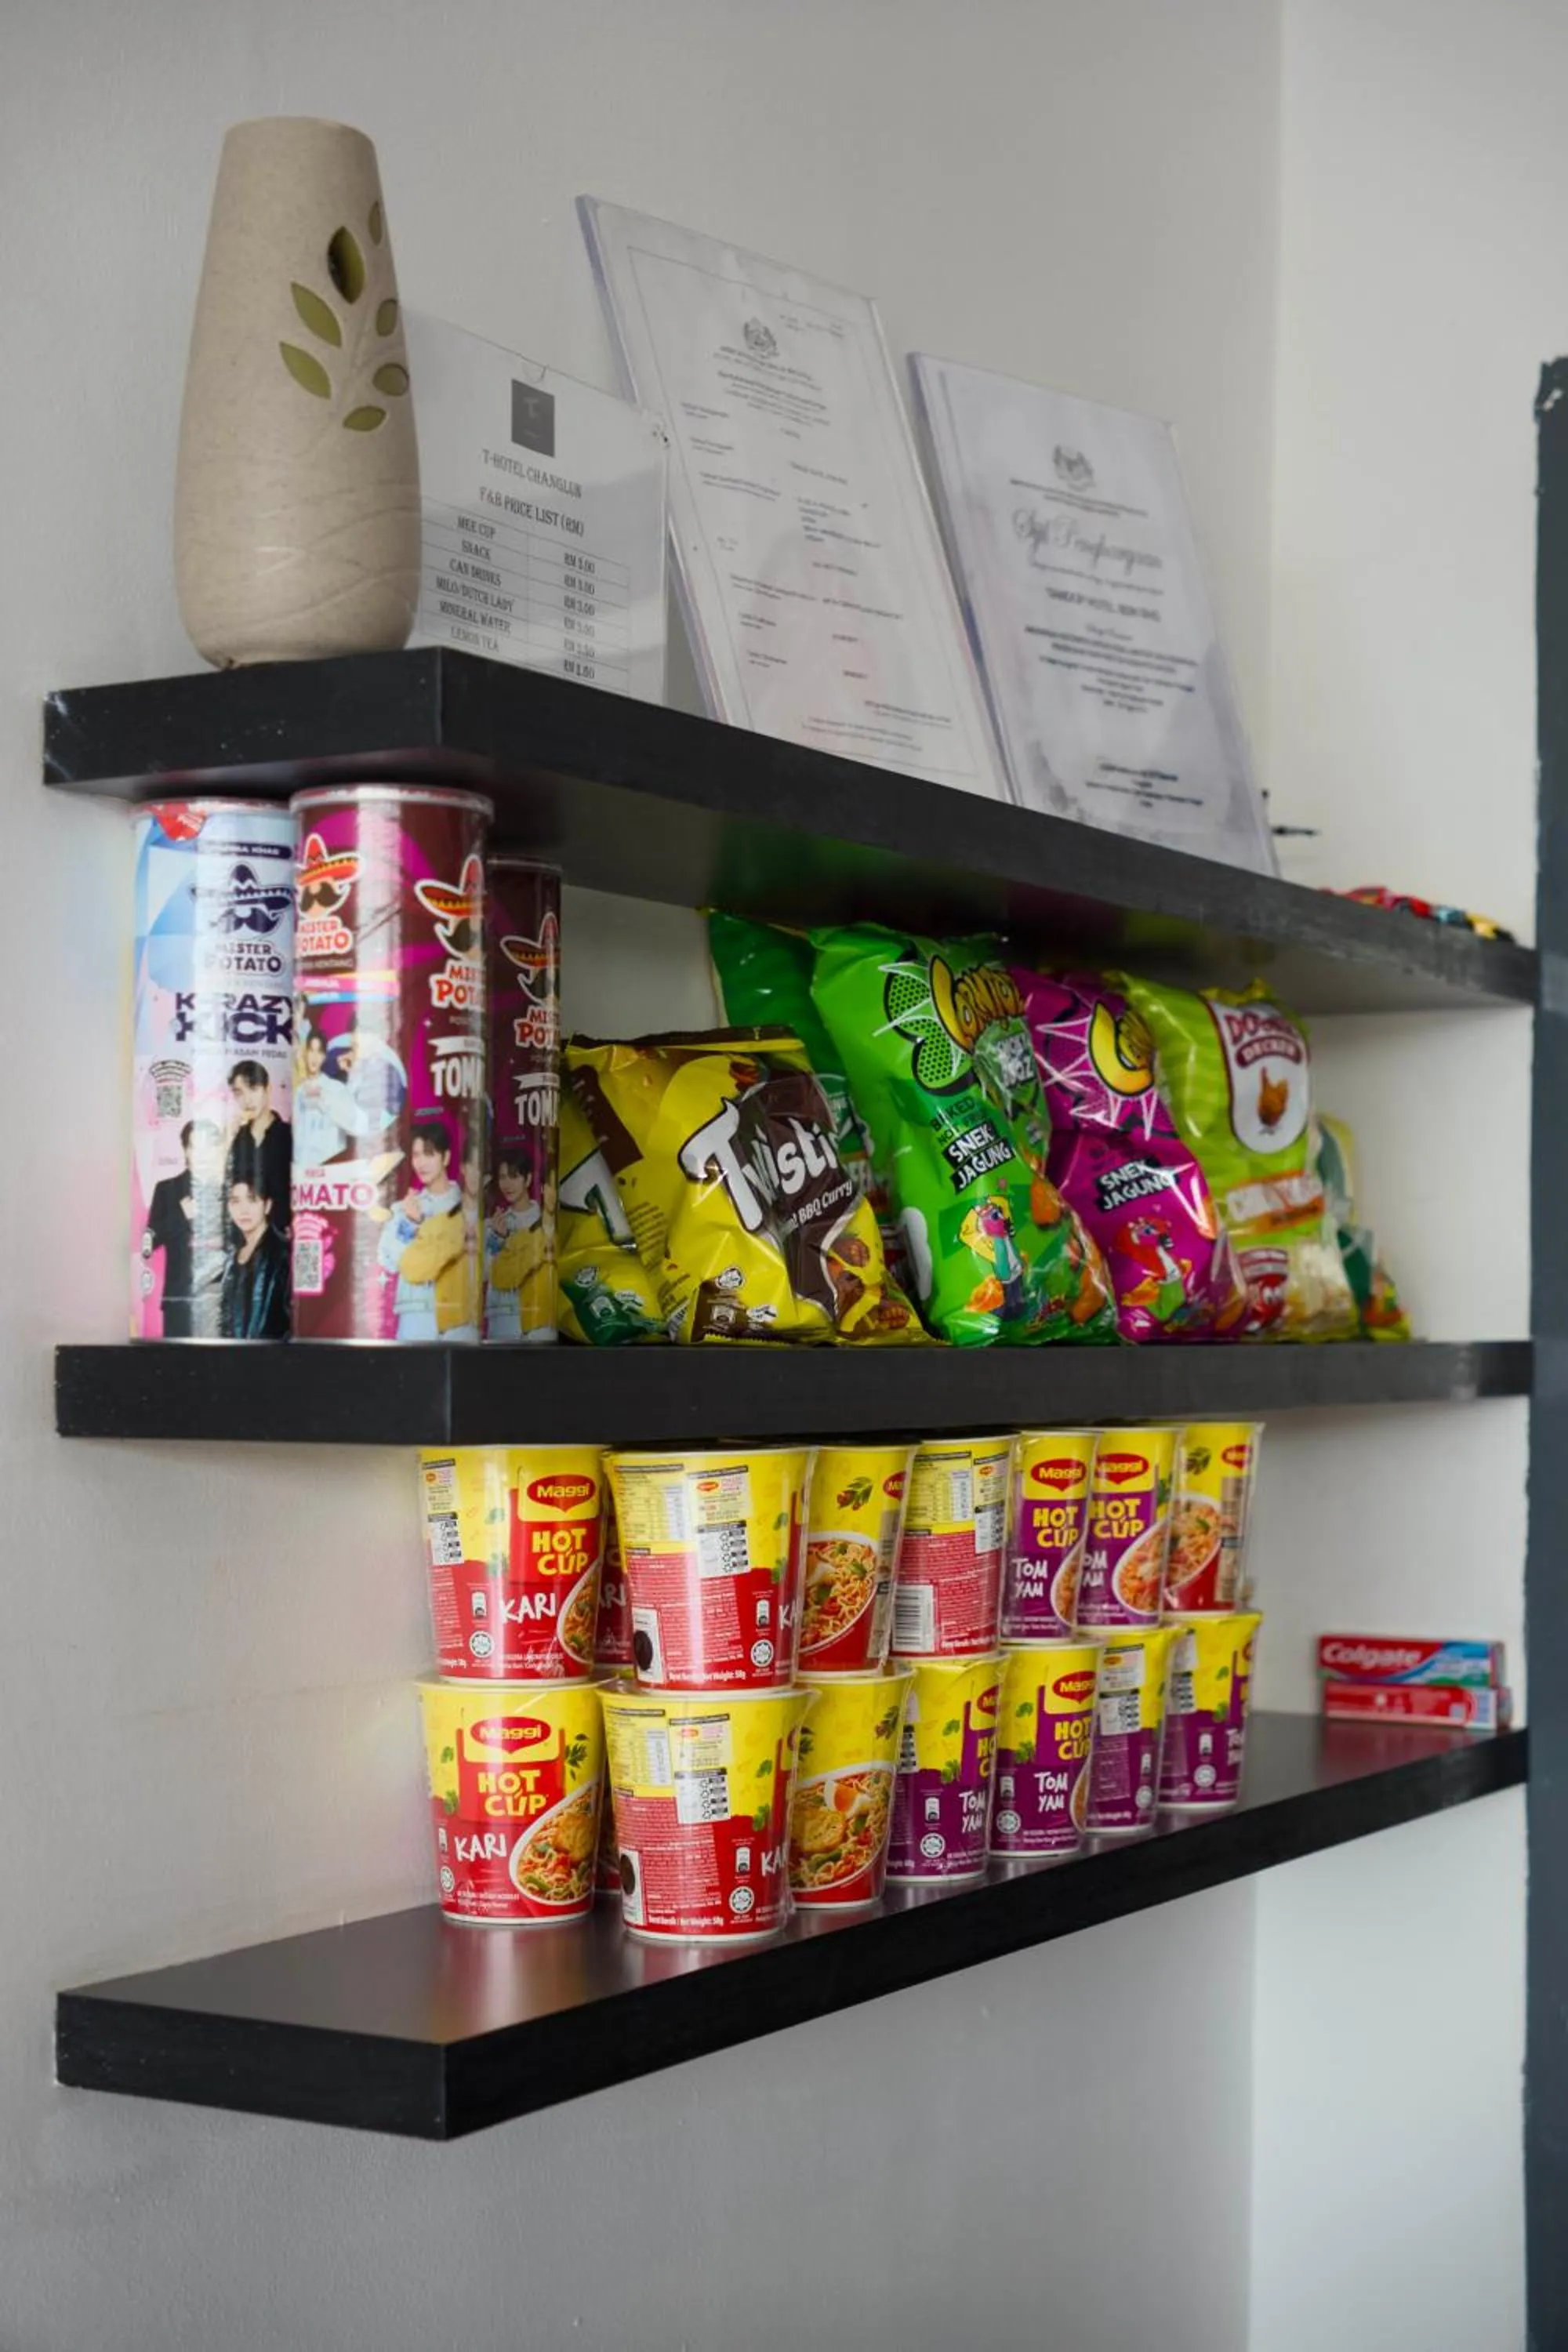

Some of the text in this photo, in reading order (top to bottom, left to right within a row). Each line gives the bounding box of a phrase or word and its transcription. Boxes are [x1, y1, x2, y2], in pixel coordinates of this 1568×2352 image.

[504, 495, 533, 519] PRICE
[535, 507, 559, 527] LIST
[458, 515, 496, 539] MEE CUP
[299, 931, 350, 952] OTATO
[947, 1123, 995, 1163] SNEK
[957, 1142, 1012, 1189] JAGUNG
[1100, 1160, 1151, 1191] SNEK
[799, 1179, 853, 1225] BBQ Curry
[1103, 1174, 1175, 1210] JAGUNG
[536, 1482, 590, 1499] Maggi
[1033, 1505, 1079, 1528] HOT
[1088, 1497, 1142, 1519] HOT
[1036, 1528, 1079, 1548] CUP
[1094, 1518, 1145, 1539] CUP
[532, 1528, 587, 1555] HOT
[536, 1552, 588, 1576] CUP
[1014, 1582, 1044, 1599] YAM
[1083, 1571, 1105, 1587] AM
[499, 1592, 557, 1624] KARI
[1323, 1642, 1421, 1670] Colgate
[479, 1724, 541, 1740] Maggi
[477, 1769, 541, 1794] HOT
[485, 1791, 547, 1817] CUP
[1038, 1795, 1065, 1813] YAM
[454, 1832, 506, 1862] KARI
